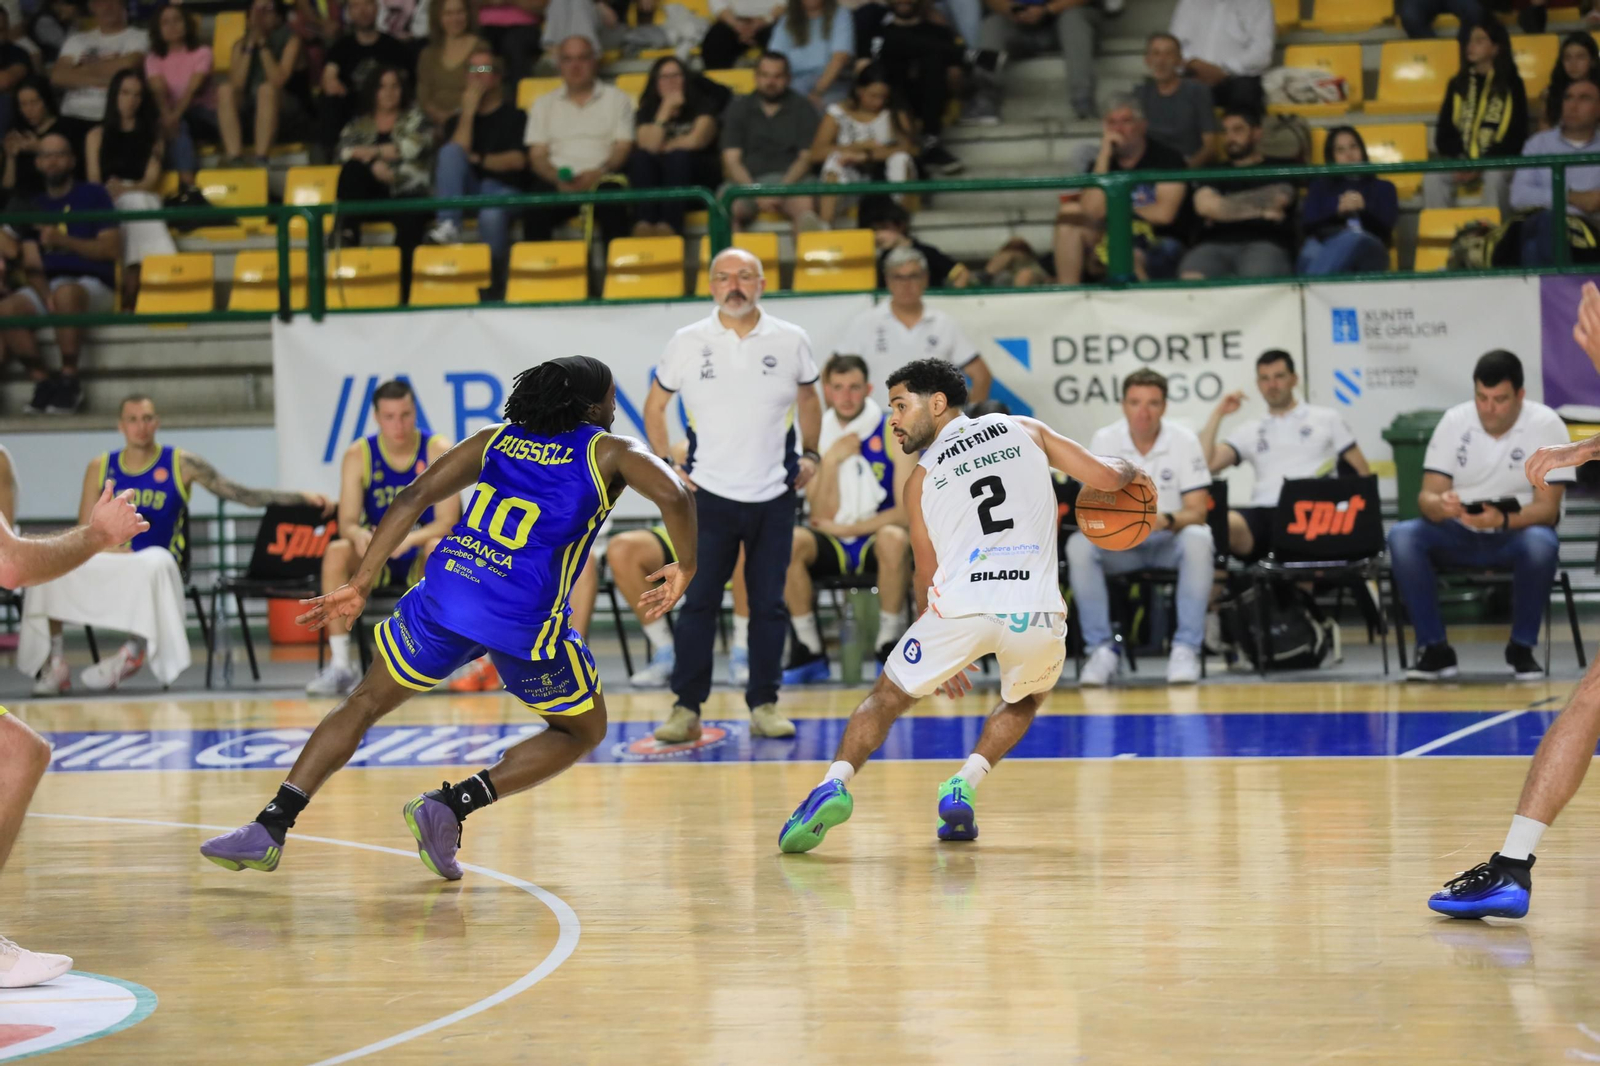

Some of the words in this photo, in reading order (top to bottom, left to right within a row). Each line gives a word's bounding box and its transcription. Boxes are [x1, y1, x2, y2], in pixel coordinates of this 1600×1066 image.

[1052, 331, 1243, 364] DEPORTE
[1054, 372, 1223, 404] GALGO
[493, 435, 574, 465] RUSSELL
[973, 446, 1021, 470] ENERGY
[467, 482, 541, 550] 10
[970, 475, 1014, 535] 2
